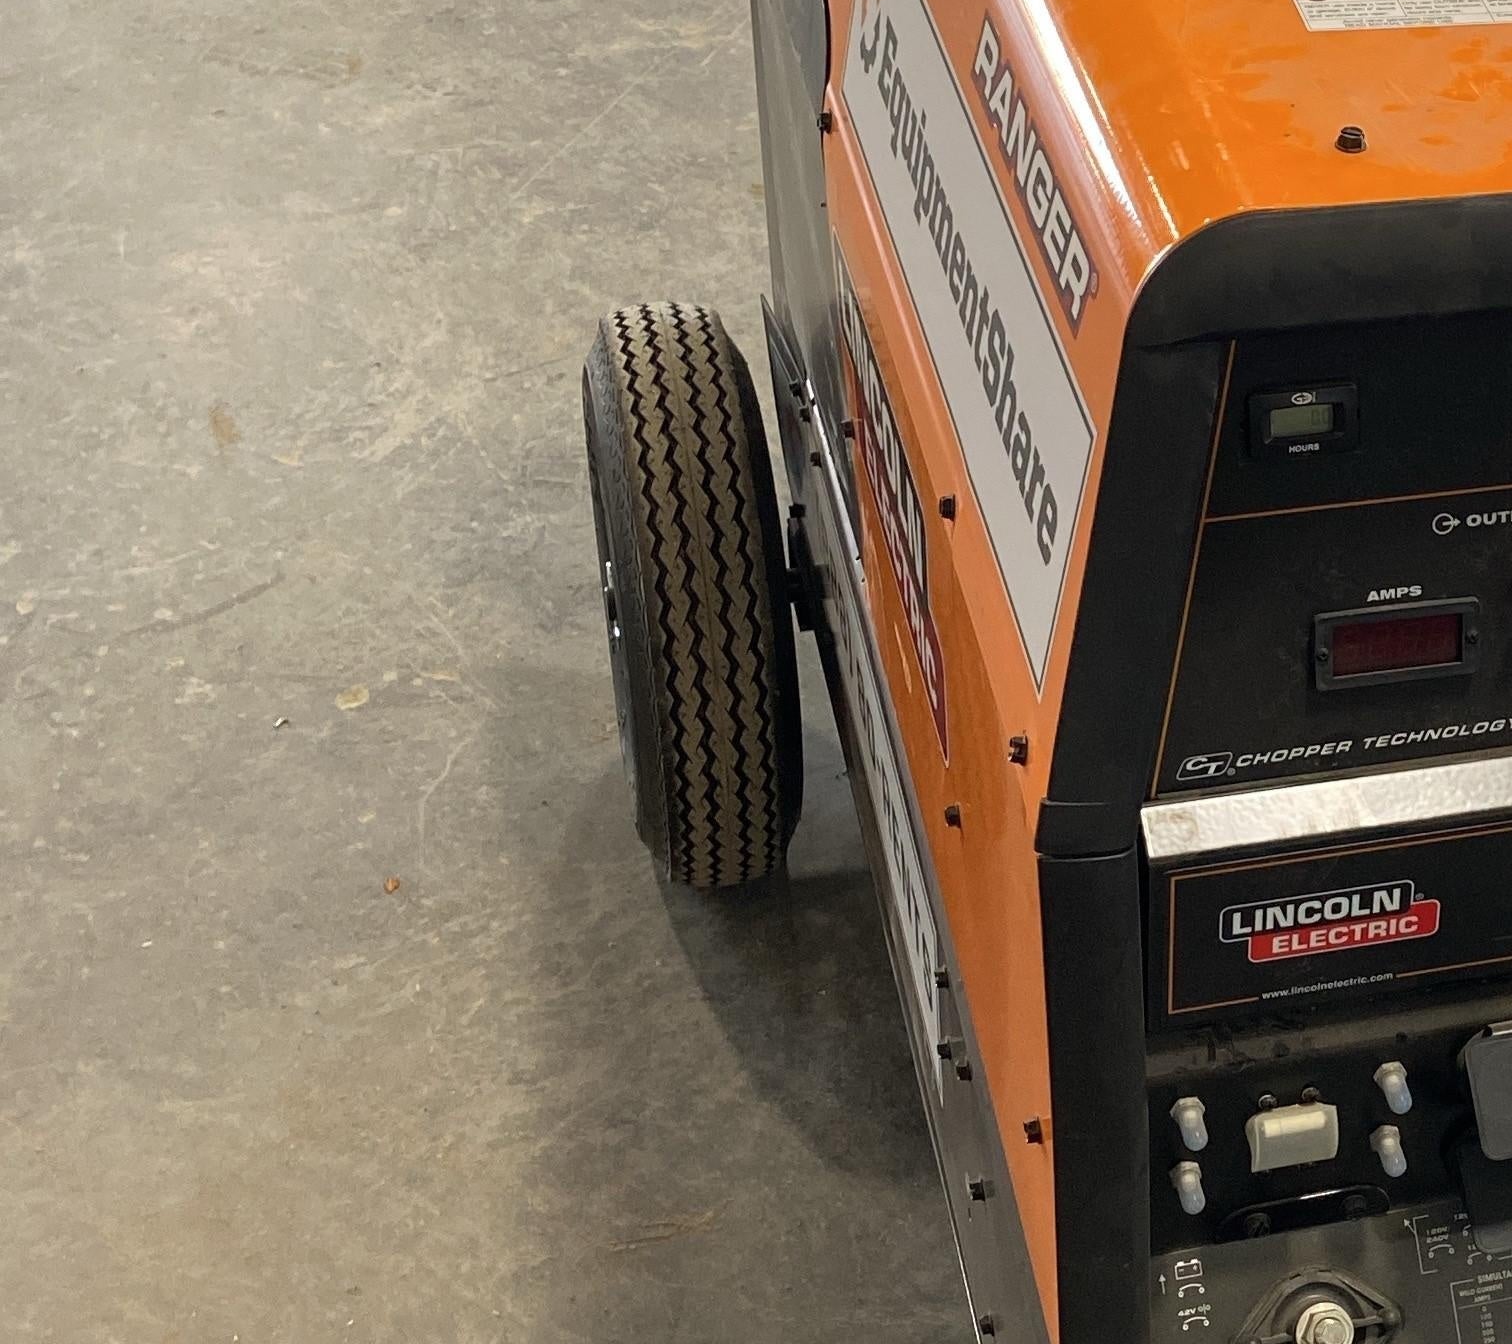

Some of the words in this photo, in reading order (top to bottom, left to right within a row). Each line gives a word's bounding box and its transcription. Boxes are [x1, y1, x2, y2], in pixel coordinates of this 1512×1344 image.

[975, 27, 1091, 321] RANGER
[877, 15, 1059, 567] EquipmentShare
[1288, 442, 1320, 454] HOURS
[1366, 585, 1423, 602] AMPS
[1236, 740, 1353, 768] CHOPPER
[1231, 887, 1402, 936] LINCOLN
[1271, 916, 1419, 954] ELECTRIC
[1261, 971, 1394, 1000] www.lincolnelectric.com
